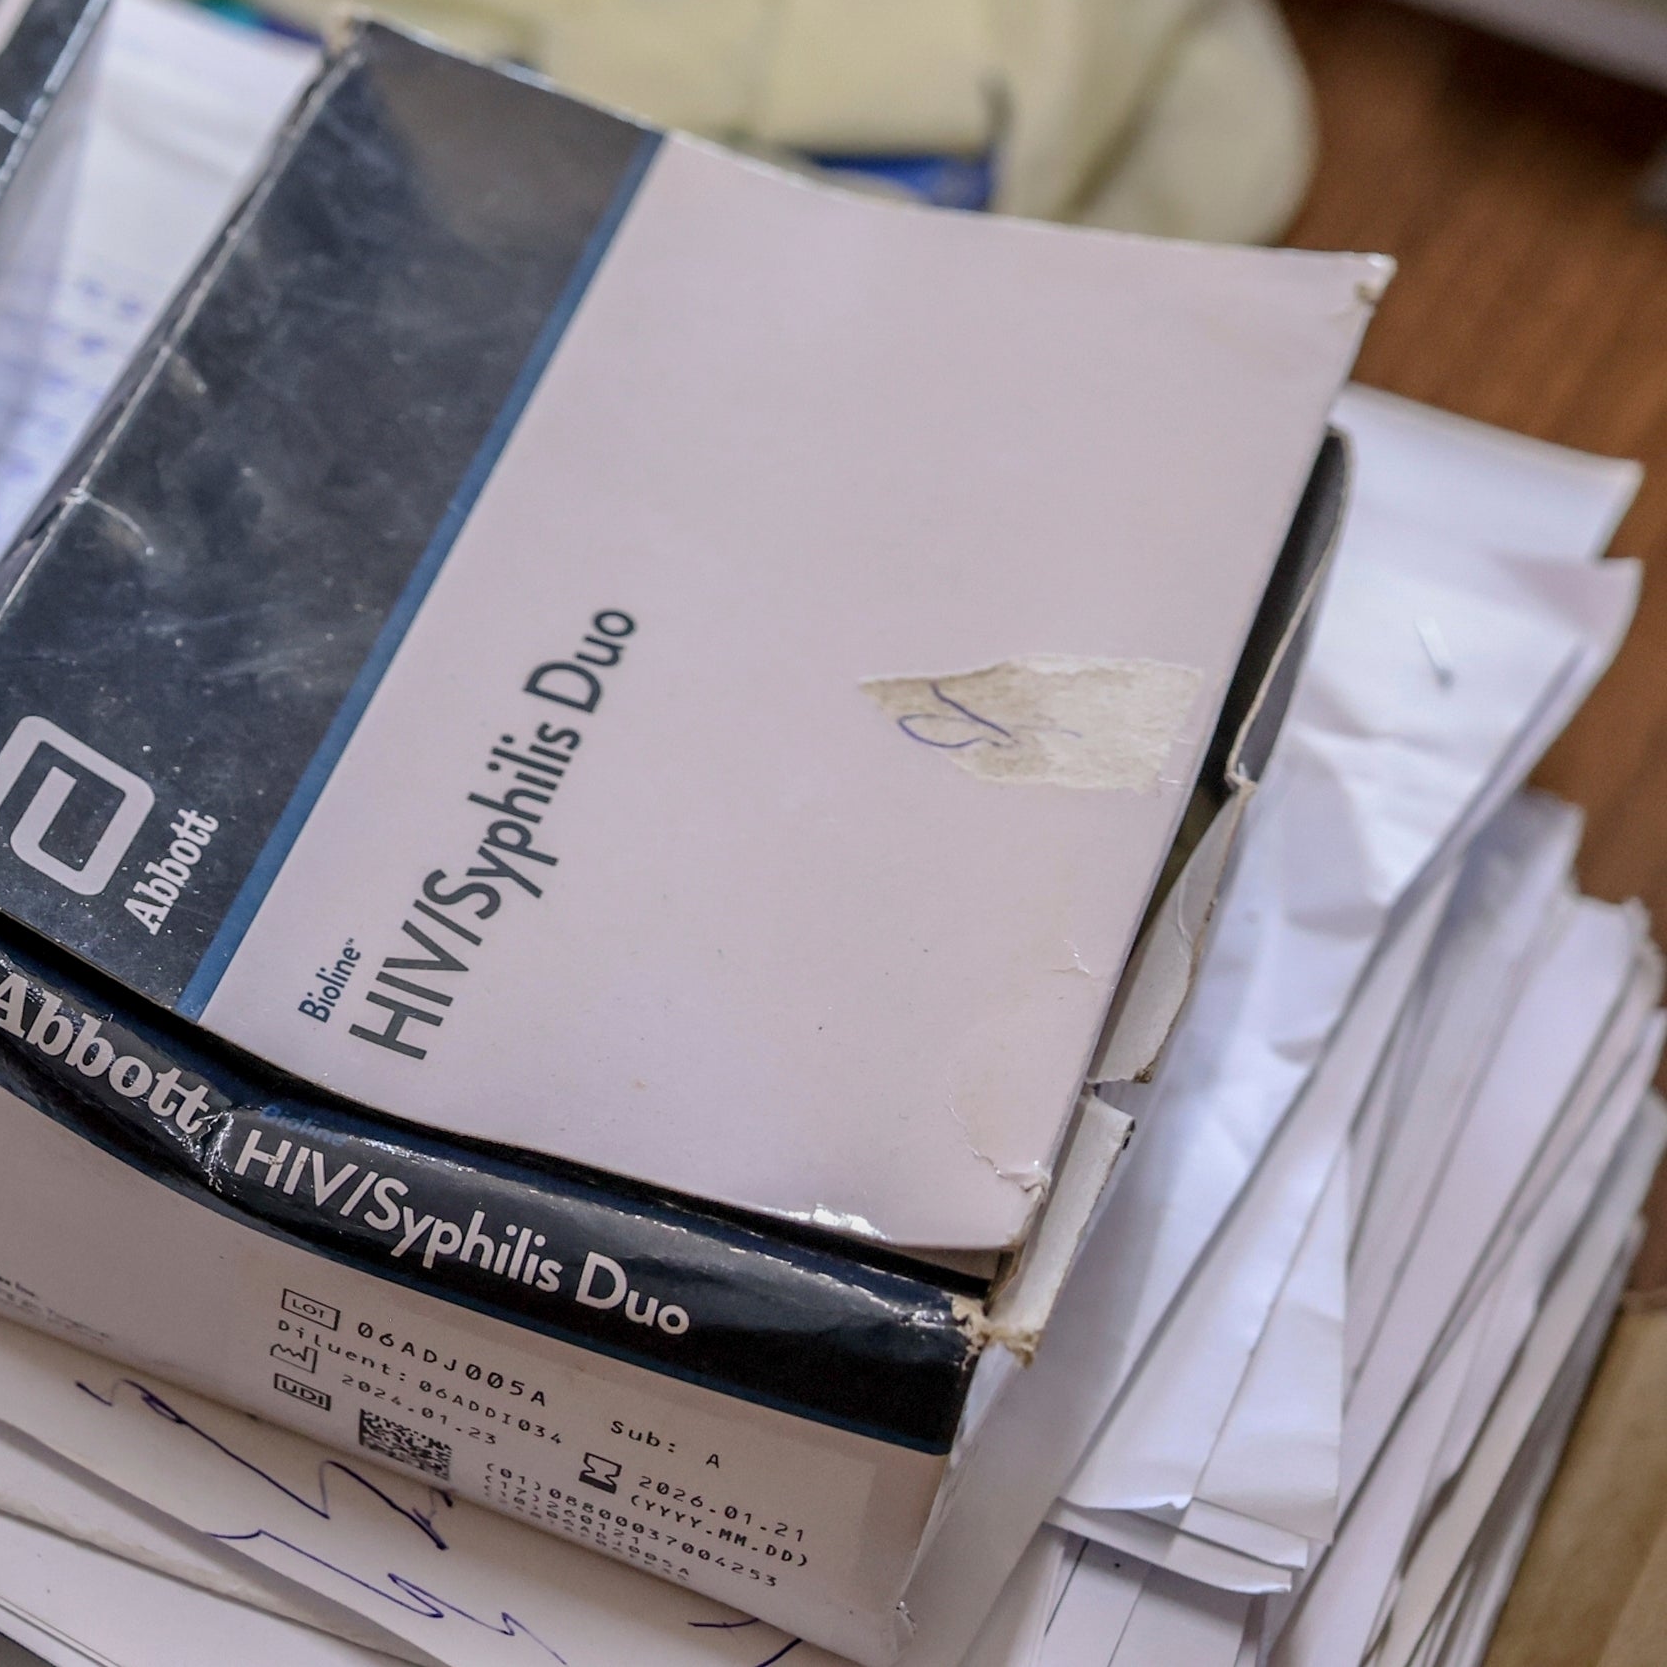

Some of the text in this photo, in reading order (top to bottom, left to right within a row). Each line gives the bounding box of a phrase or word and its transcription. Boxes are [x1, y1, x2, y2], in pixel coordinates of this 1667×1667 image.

[124, 808, 219, 936] Abbott
[348, 609, 636, 1061] HIV/Syphilis Duo
[234, 1129, 564, 1293] HIV/Syphilis
[580, 1252, 689, 1338] Duo
[277, 1319, 406, 1382] Diluent:
[290, 1299, 720, 1469] LOT 06ADJ005A Sub: A
[279, 1382, 808, 1567] UDI (YYYY.MM.DD)
[341, 1373, 804, 1543] 2024.01.23 2026.01.21
